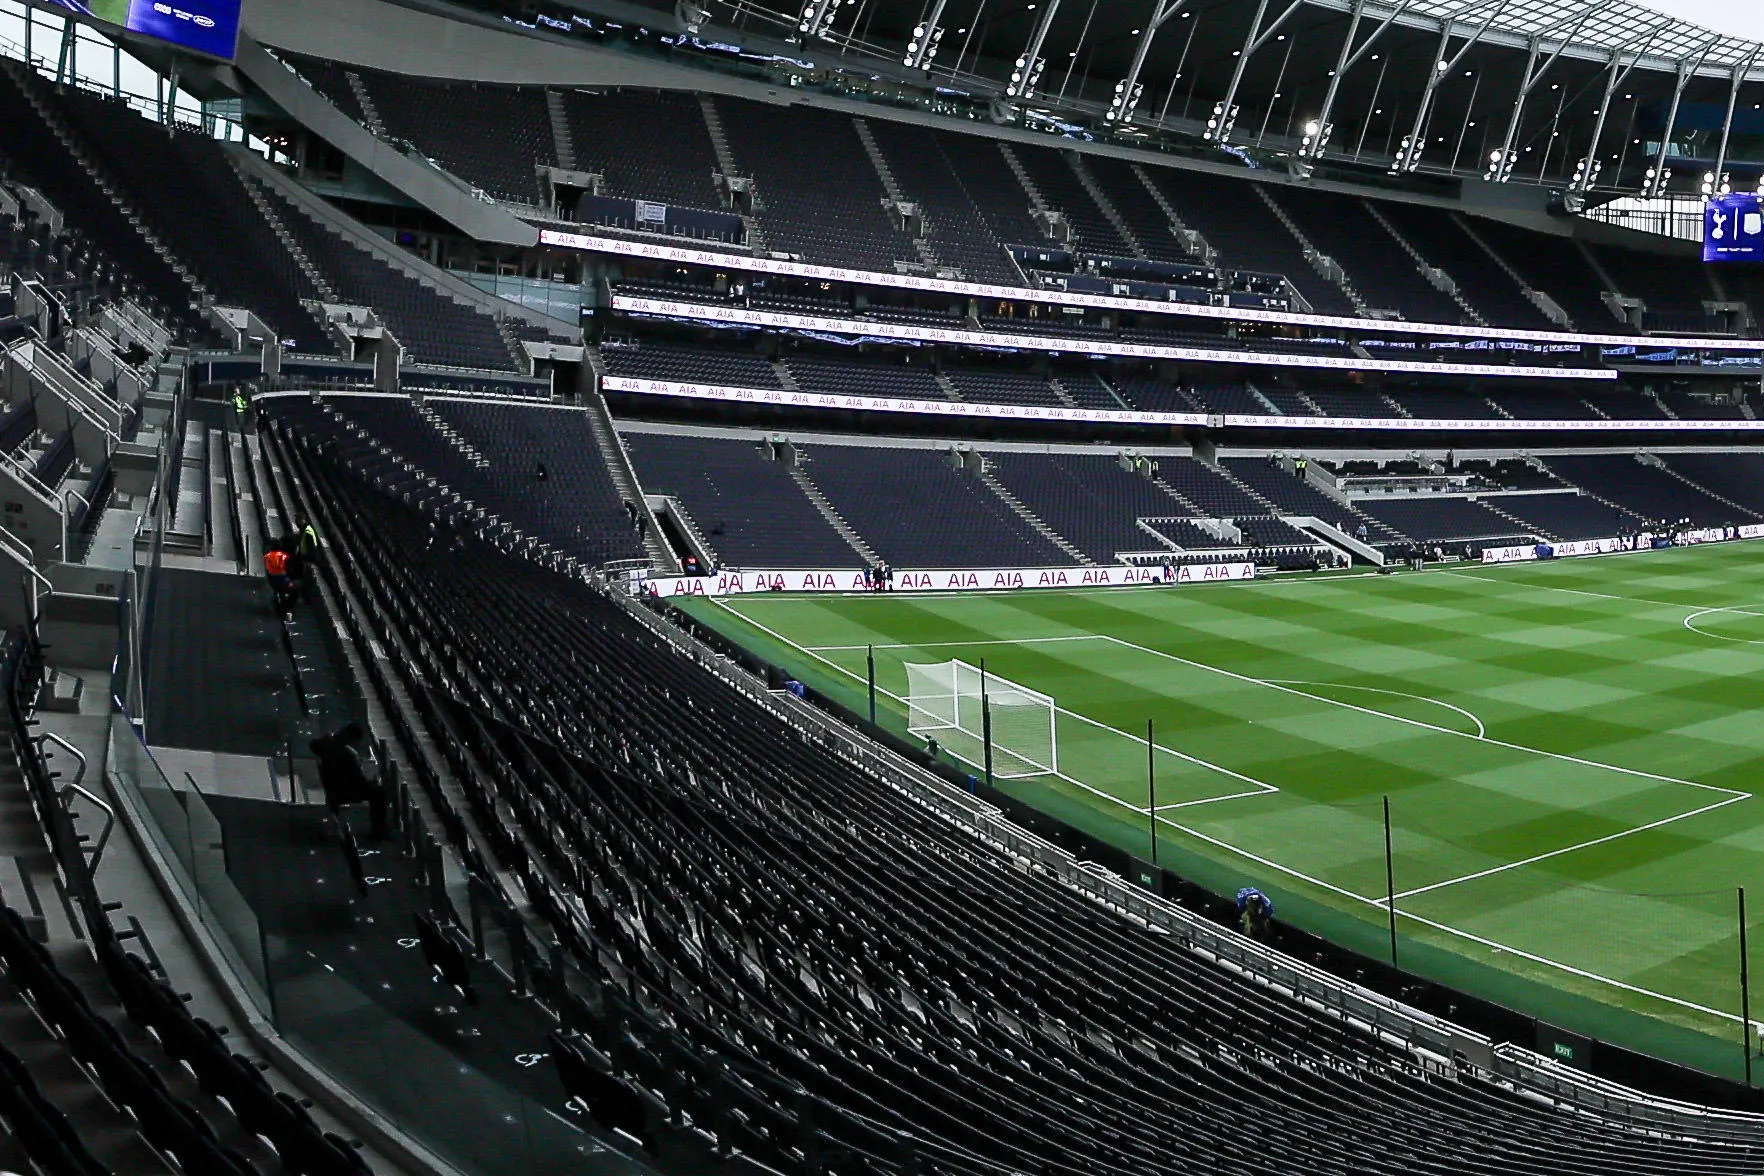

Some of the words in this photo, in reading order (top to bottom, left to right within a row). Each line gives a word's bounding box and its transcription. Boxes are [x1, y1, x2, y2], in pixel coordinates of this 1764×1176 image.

[557, 234, 576, 244] AIA
[586, 238, 604, 248] AIA
[614, 242, 631, 252] AIA
[641, 246, 659, 255] AIA
[669, 250, 686, 258] AIA
[696, 253, 714, 262] AIA
[724, 256, 741, 266] AIA
[750, 260, 767, 269] AIA
[776, 263, 794, 272] AIA
[803, 266, 819, 274] AIA
[828, 269, 845, 278] AIA
[855, 272, 870, 280] AIA
[631, 300, 649, 310] AIA
[659, 303, 677, 312] AIA
[688, 306, 705, 315] AIA
[716, 309, 734, 319] AIA
[744, 312, 761, 321] AIA
[771, 315, 788, 324] AIA
[799, 318, 815, 327] AIA
[825, 320, 842, 329] AIA
[852, 323, 869, 332] AIA
[878, 326, 894, 334] AIA
[904, 328, 920, 336] AIA
[929, 330, 945, 339] AIA
[954, 332, 970, 340] AIA
[620, 380, 639, 389] AIA
[650, 382, 668, 392] AIA
[678, 385, 697, 394] AIA
[707, 388, 725, 397] AIA
[735, 390, 753, 399] AIA
[763, 392, 781, 401] AIA
[791, 394, 808, 403] AIA
[818, 396, 835, 405] AIA
[845, 398, 862, 406] AIA
[872, 400, 888, 408] AIA
[898, 401, 915, 409] AIA
[924, 403, 940, 411] AIA
[950, 404, 965, 412] AIA
[974, 406, 991, 414] AIA
[999, 407, 1015, 415] AIA
[1024, 408, 1039, 416] AIA
[1072, 410, 1087, 418] AIA
[1503, 548, 1522, 560] AIA
[1558, 543, 1576, 554] AIA
[674, 579, 704, 595] AIA
[803, 573, 836, 588] AIA
[900, 573, 932, 587] AIA
[948, 572, 978, 587] AIA
[994, 572, 1023, 586] AIA
[1038, 571, 1067, 584] AIA
[1082, 569, 1110, 583] AIA
[1124, 569, 1151, 582] AIA
[1204, 565, 1230, 579] AIA
